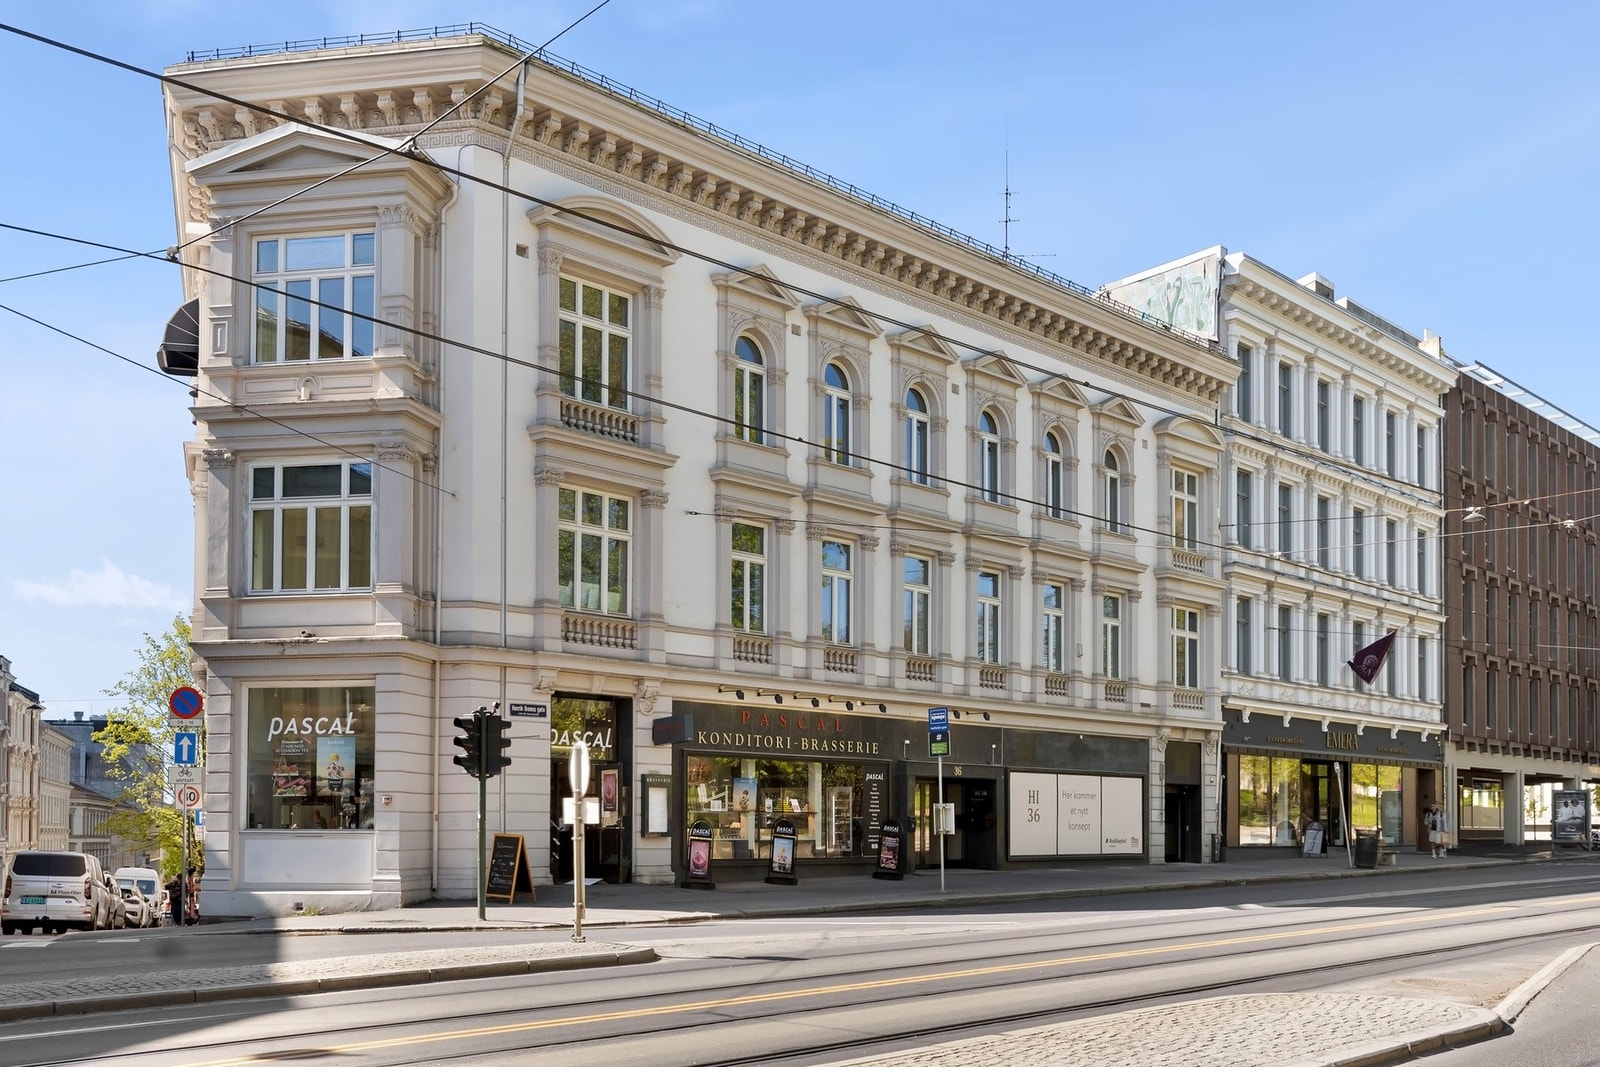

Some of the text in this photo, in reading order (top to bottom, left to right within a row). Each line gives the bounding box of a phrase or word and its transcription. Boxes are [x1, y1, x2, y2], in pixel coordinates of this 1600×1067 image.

[741, 711, 842, 732] PASCAL
[697, 731, 879, 754] KONDITORI-BRASSERIE
[1326, 731, 1358, 749] EMERA
[953, 766, 962, 776] 36
[1028, 789, 1040, 805] HI
[1062, 791, 1097, 801] Her kommer
[1027, 807, 1041, 823] 36
[1070, 807, 1089, 818] et nytt
[1067, 821, 1091, 832] konsept
